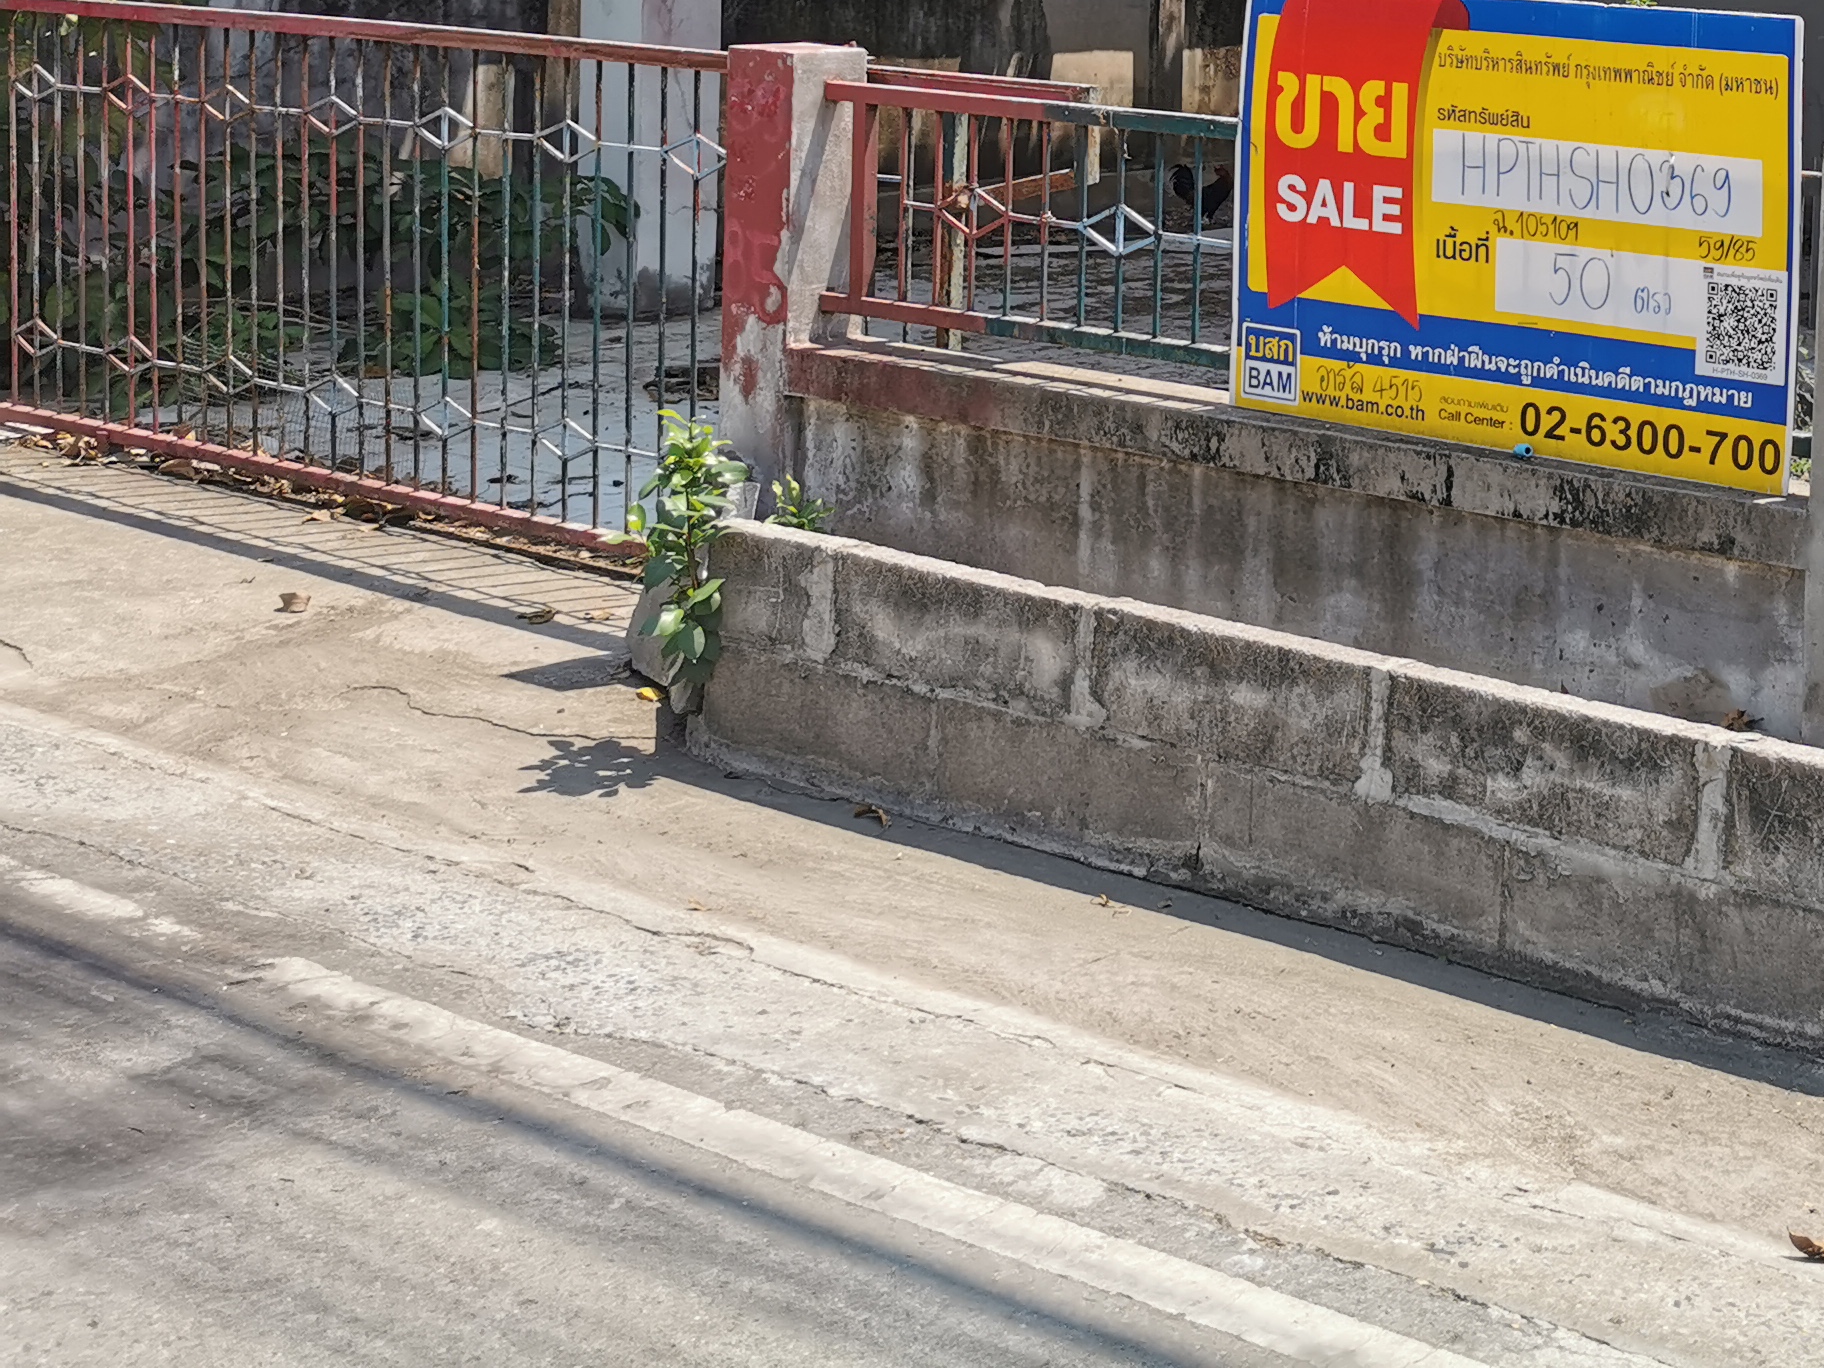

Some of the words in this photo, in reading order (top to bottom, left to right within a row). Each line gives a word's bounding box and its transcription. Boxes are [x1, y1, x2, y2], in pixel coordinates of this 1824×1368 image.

[1678, 64, 1715, 91] จำกัด
[1719, 72, 1779, 100] (มหาชน)
[1275, 71, 1409, 159] ขาย
[1437, 104, 1531, 129] รหัสทรัพย์สิน
[1276, 173, 1403, 235] SALE
[1436, 226, 1490, 264] เนื้อที่
[1698, 235, 1757, 262] 59/85
[1549, 252, 1611, 310] 50
[1248, 334, 1294, 362] บสก
[1318, 324, 1401, 364] ห้ามบุกรุก
[1248, 367, 1292, 395] BAM
[1301, 389, 1426, 422] www.bam.co.th
[1438, 408, 1461, 423] Call
[1464, 412, 1506, 429] Center
[1519, 401, 1781, 476] 02-6300-700
